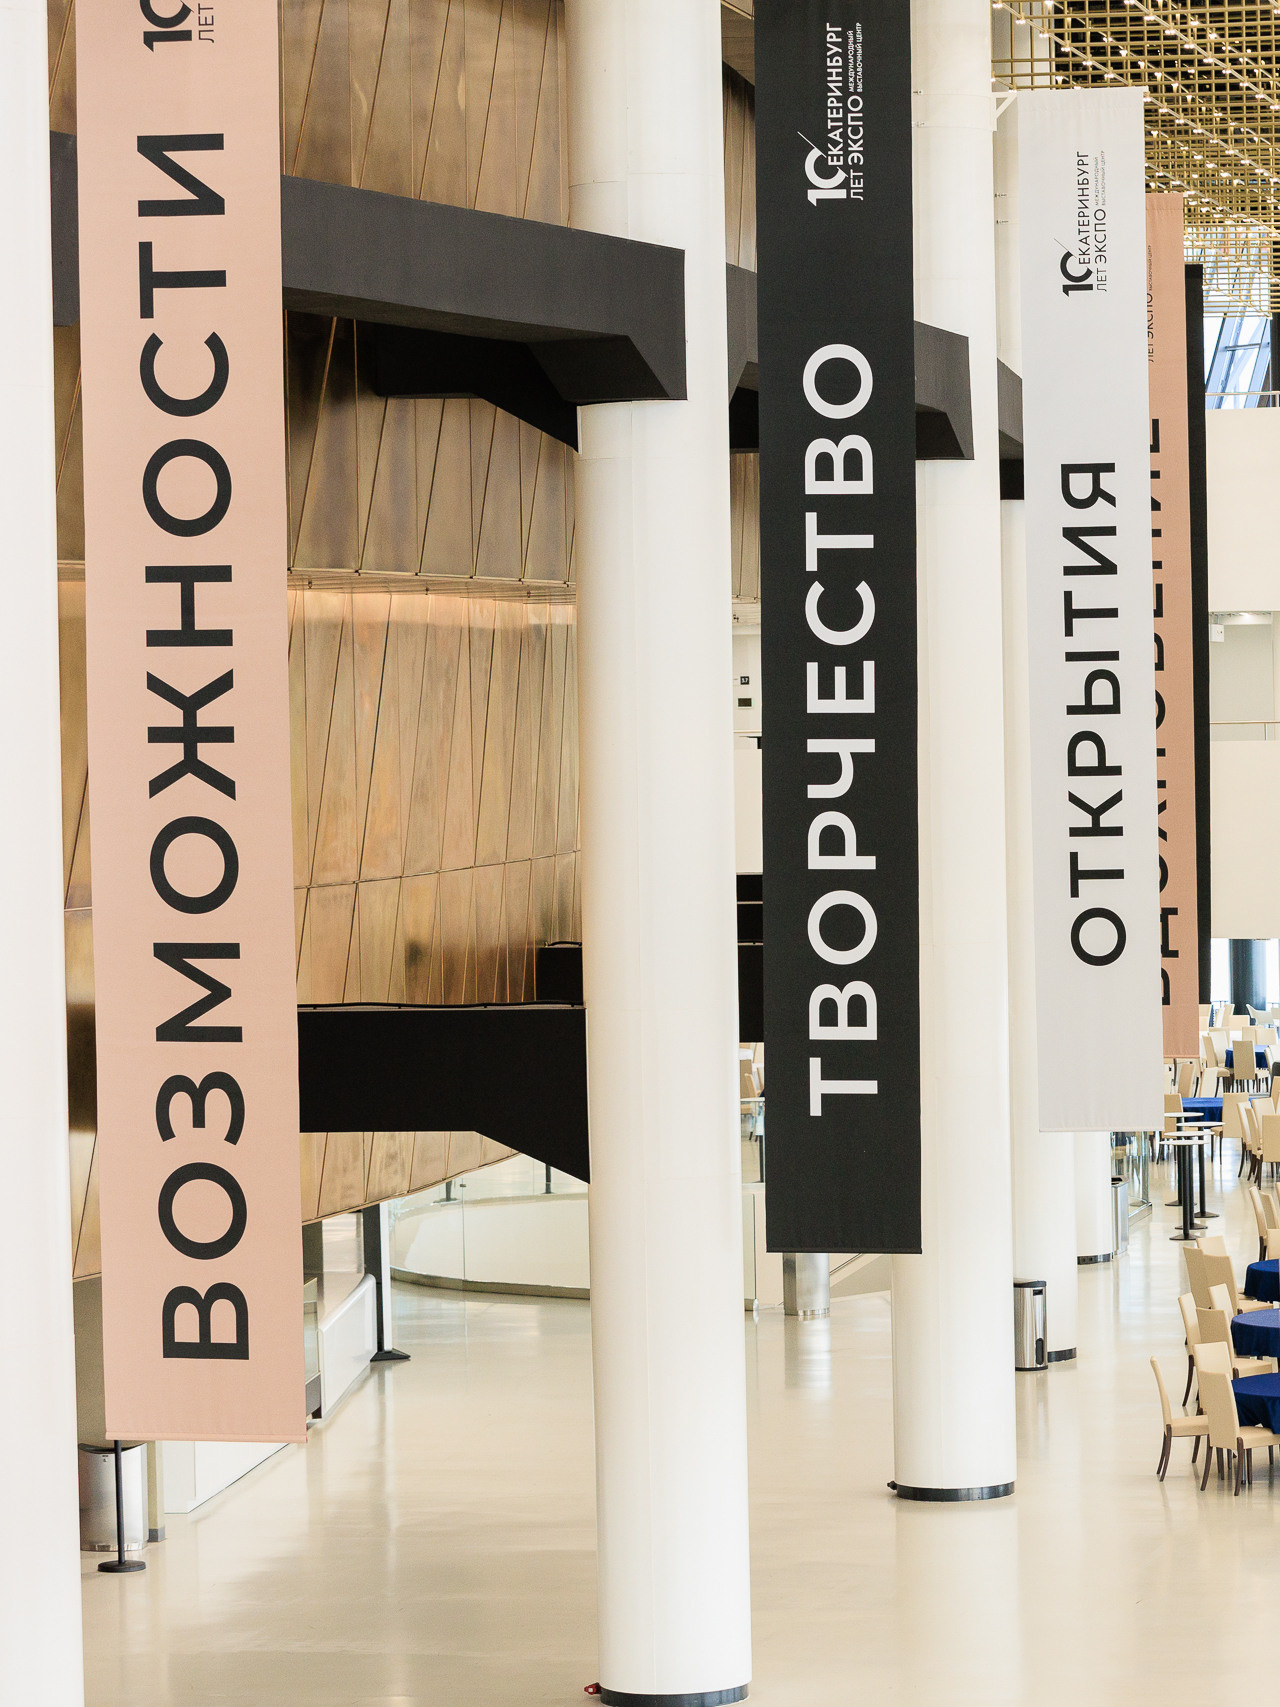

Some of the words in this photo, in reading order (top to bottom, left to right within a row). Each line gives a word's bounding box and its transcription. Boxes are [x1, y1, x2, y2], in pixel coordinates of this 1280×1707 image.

[198, 3, 214, 43] ЛЕТ
[855, 22, 863, 42] ЦЕНТР
[847, 30, 855, 93] МЕЖДУНАРОДНЫЙ
[855, 43, 863, 93] ВЫСТАВОЧНЫЙ
[826, 22, 844, 166] ЕКАТЕРИНБУРГ
[847, 95, 864, 165] ЭКСПО
[850, 169, 864, 201] ЛЕТ
[1077, 151, 1090, 265] ЕКАТЕРИНБУРГ
[1094, 208, 1106, 264] ЭКСПО
[1097, 268, 1107, 292] ЛЕТ
[802, 343, 878, 1117] ТВОРЧЕСТВО
[1061, 463, 1127, 967] ОТКРЫТИЯ
[137, 133, 250, 1361] ВОЗМОЖНОСТИ
